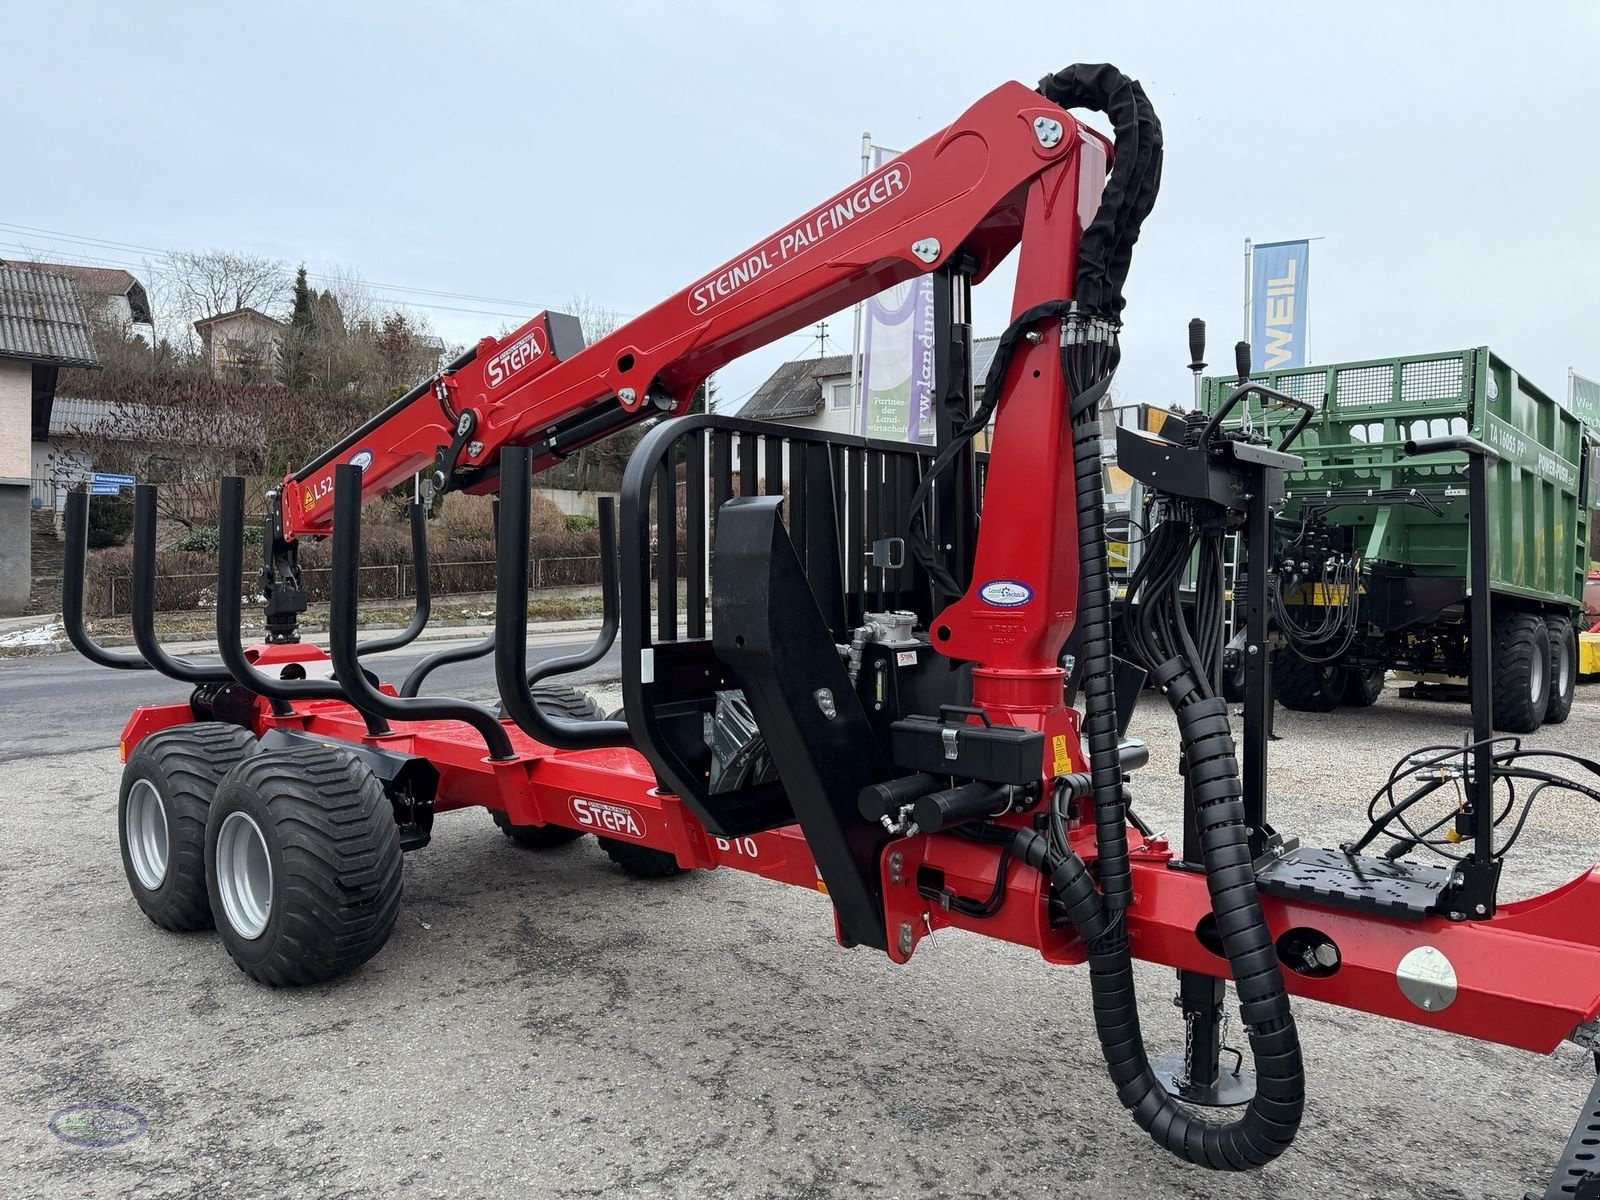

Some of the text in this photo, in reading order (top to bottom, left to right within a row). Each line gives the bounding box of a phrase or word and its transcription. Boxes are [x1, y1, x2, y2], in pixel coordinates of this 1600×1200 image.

[694, 169, 903, 310] STEINDL-PALFINGER
[1264, 259, 1296, 370] WEIL
[488, 338, 542, 386] STEPA
[872, 397, 905, 406] Partner
[881, 405, 897, 414] der
[876, 415, 901, 423] Land-
[1490, 423, 1498, 444] TA
[573, 798, 641, 836] STEPA
[735, 837, 758, 858] 10
